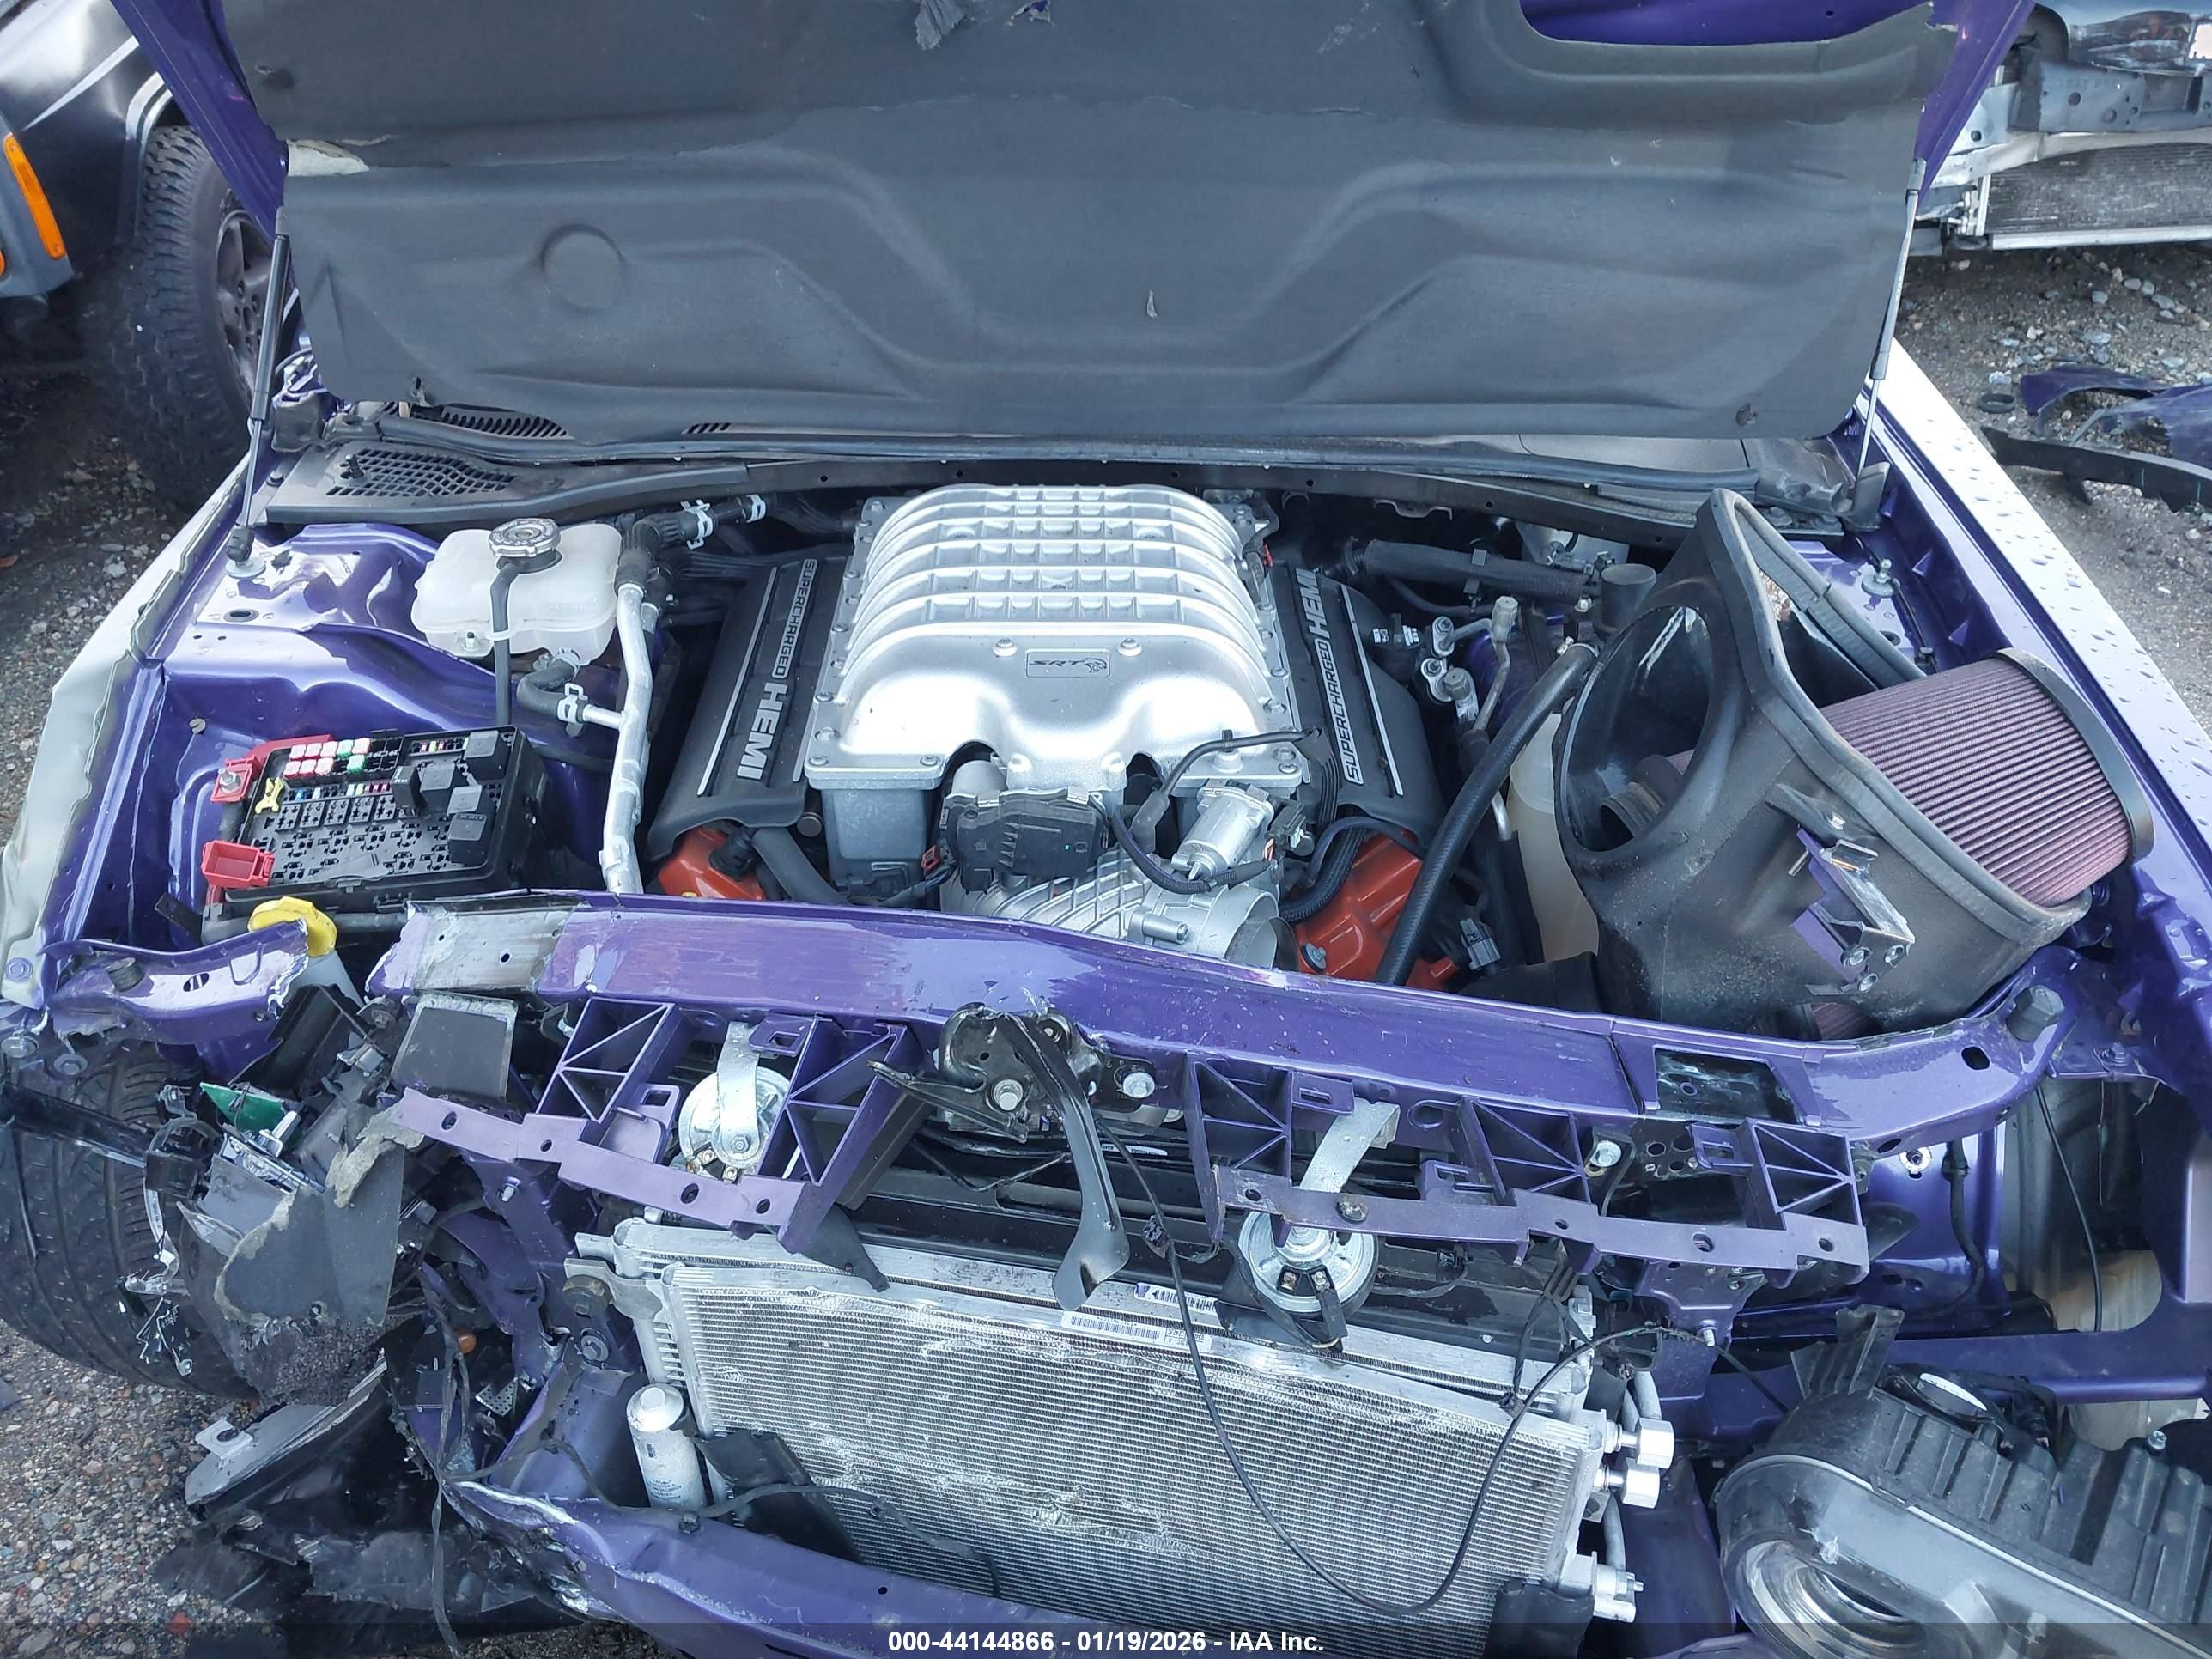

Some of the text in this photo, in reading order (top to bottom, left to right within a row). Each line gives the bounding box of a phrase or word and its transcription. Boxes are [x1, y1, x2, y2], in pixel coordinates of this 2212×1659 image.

[737, 560, 817, 780] SUPERCHARGED HEMI
[1296, 568, 1363, 784] SUPERCHARGED HEMI
